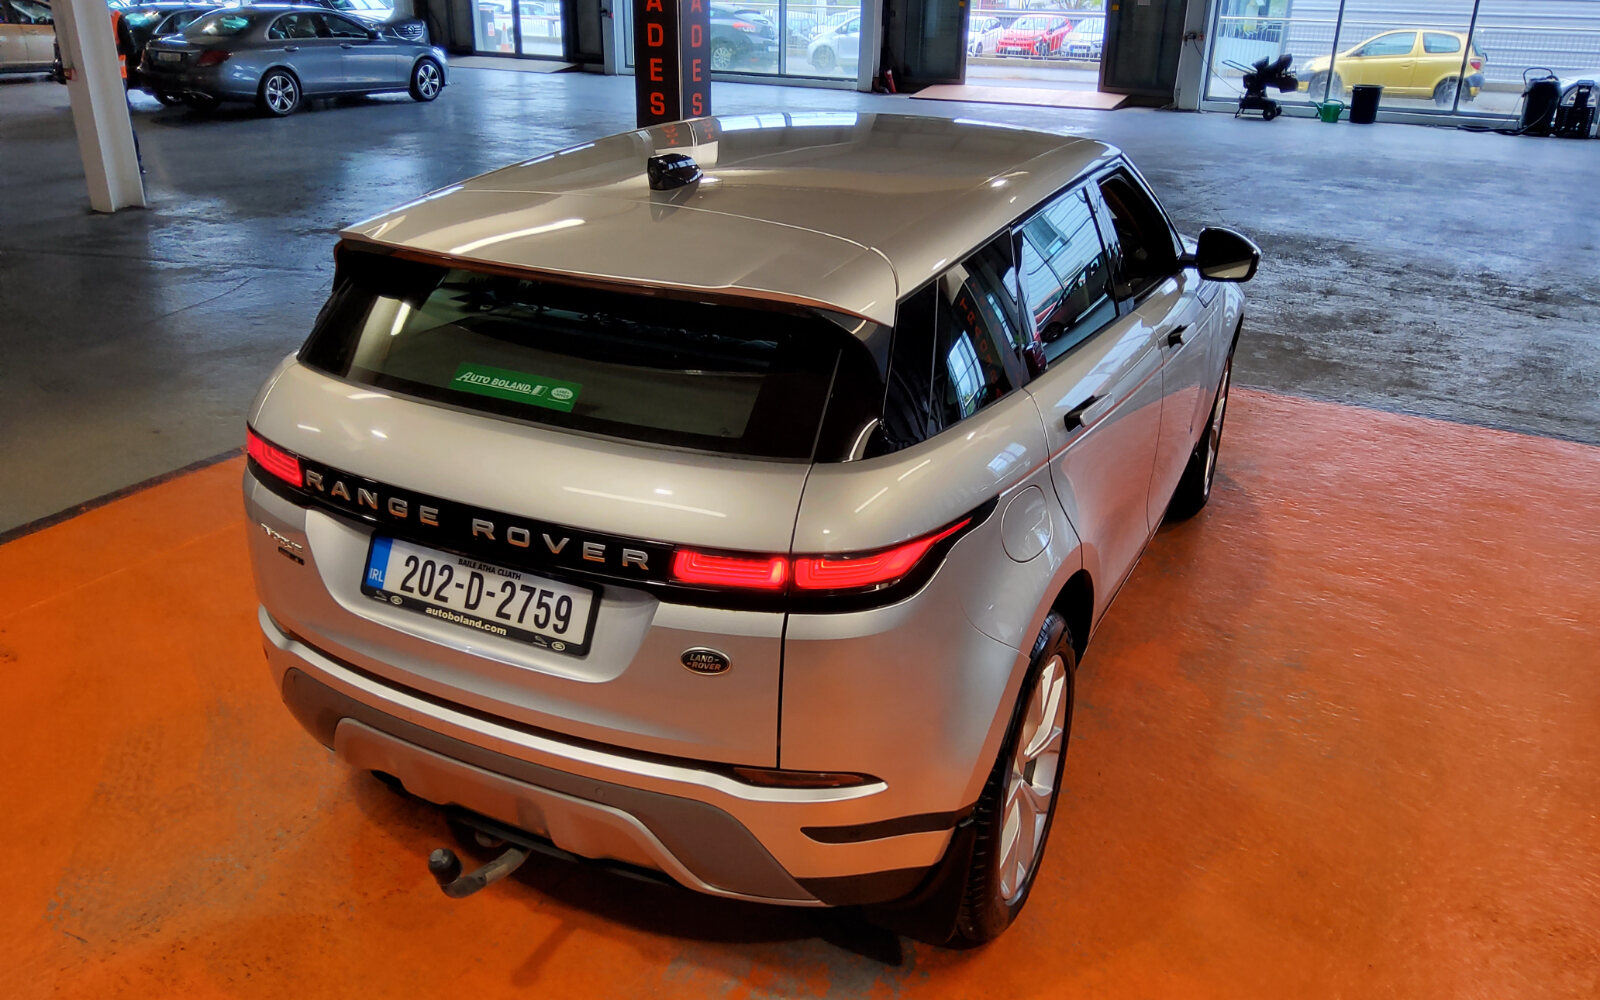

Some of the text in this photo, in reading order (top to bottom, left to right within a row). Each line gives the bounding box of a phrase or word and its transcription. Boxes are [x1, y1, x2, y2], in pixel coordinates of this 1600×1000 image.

[305, 469, 650, 571] RANGE ROVER
[369, 567, 384, 583] IRL
[458, 558, 477, 569] BAILE
[400, 555, 573, 635] 202-D-2759
[425, 607, 507, 635] autoboland.com
